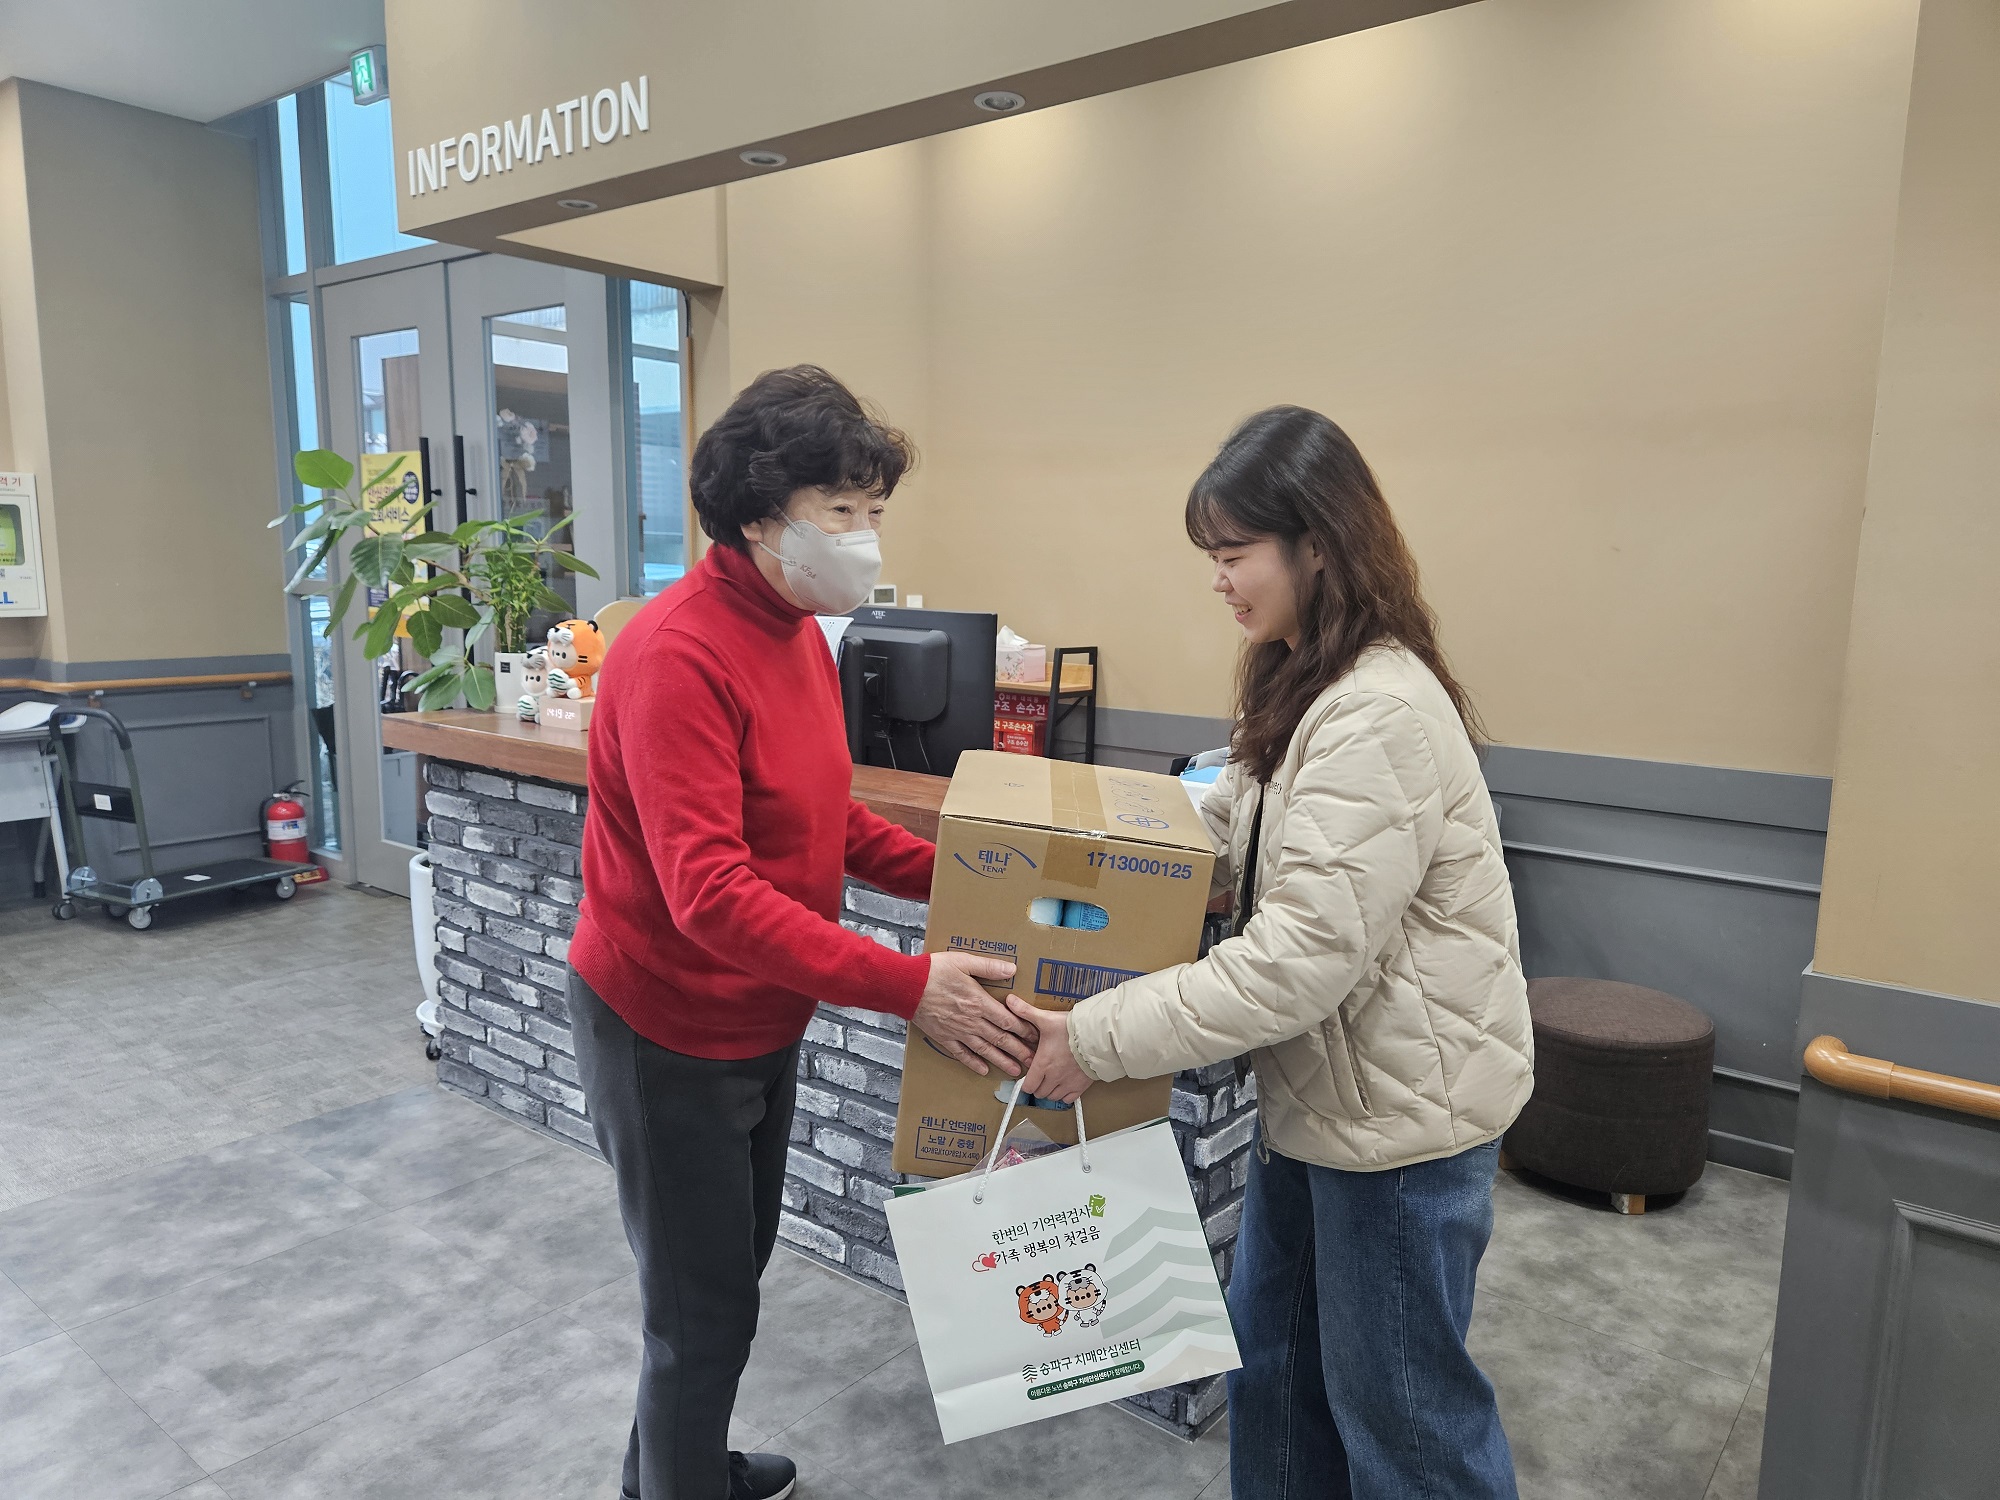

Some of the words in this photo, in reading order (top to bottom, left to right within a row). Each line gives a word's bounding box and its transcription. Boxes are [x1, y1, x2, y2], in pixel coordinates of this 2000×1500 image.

[408, 75, 649, 197] INFORMATION
[800, 564, 817, 579] KF94
[1016, 702, 1046, 716] 손수건
[1002, 721, 1034, 732] 구조손수건
[978, 849, 1011, 866] 테나
[1087, 851, 1193, 880] 1713000125
[981, 864, 1004, 875] TENA
[928, 1134, 947, 1146] 노말
[957, 1138, 975, 1150] 중형
[991, 1222, 1029, 1245] 한번의
[1032, 1204, 1092, 1232] 기억력검사
[995, 1248, 1020, 1265] 가족
[1023, 1235, 1061, 1258] 행복의
[1064, 1225, 1101, 1248] 첫걸음
[1040, 1356, 1073, 1376] 송파구
[1075, 1338, 1142, 1366] 치매안심센터
[1062, 1379, 1079, 1390] 송파구
